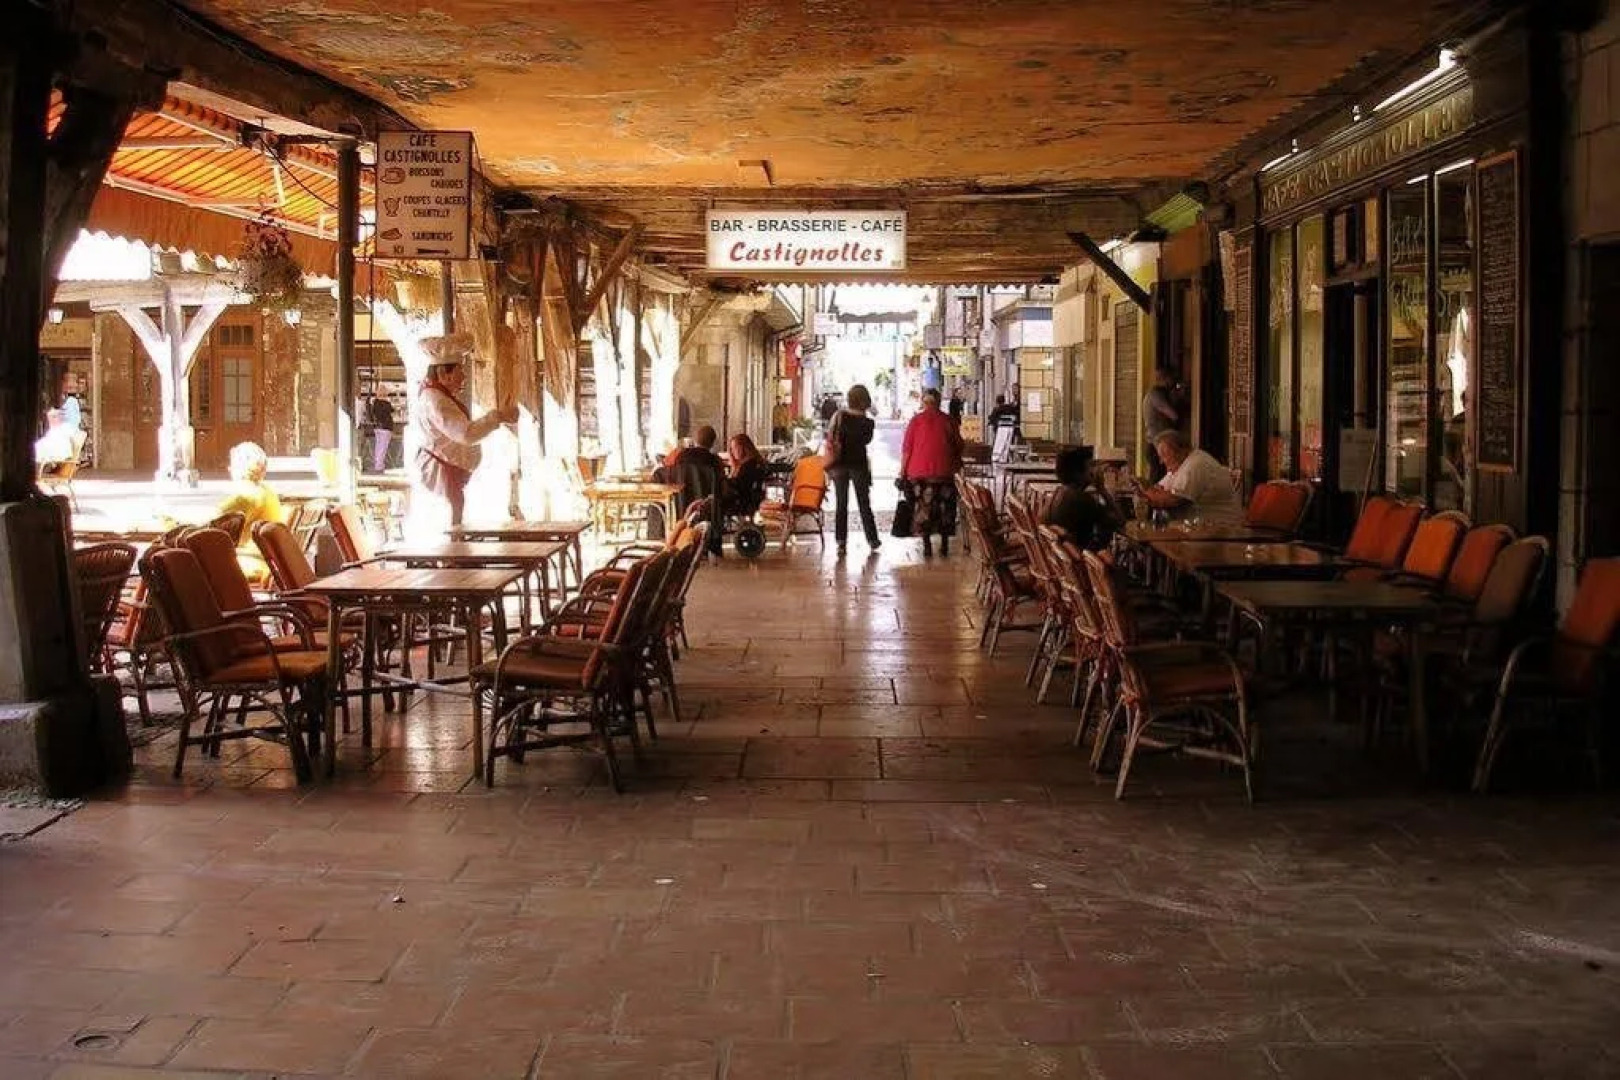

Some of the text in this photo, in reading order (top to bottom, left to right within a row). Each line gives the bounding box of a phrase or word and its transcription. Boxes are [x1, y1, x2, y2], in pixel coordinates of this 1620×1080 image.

[409, 134, 437, 147] CAFE
[384, 150, 461, 163] CASTIGNOLLES
[403, 196, 432, 205] COUPES
[710, 219, 744, 232] BAR
[757, 219, 847, 232] BRASSERIE
[729, 241, 884, 266] Castignolles
